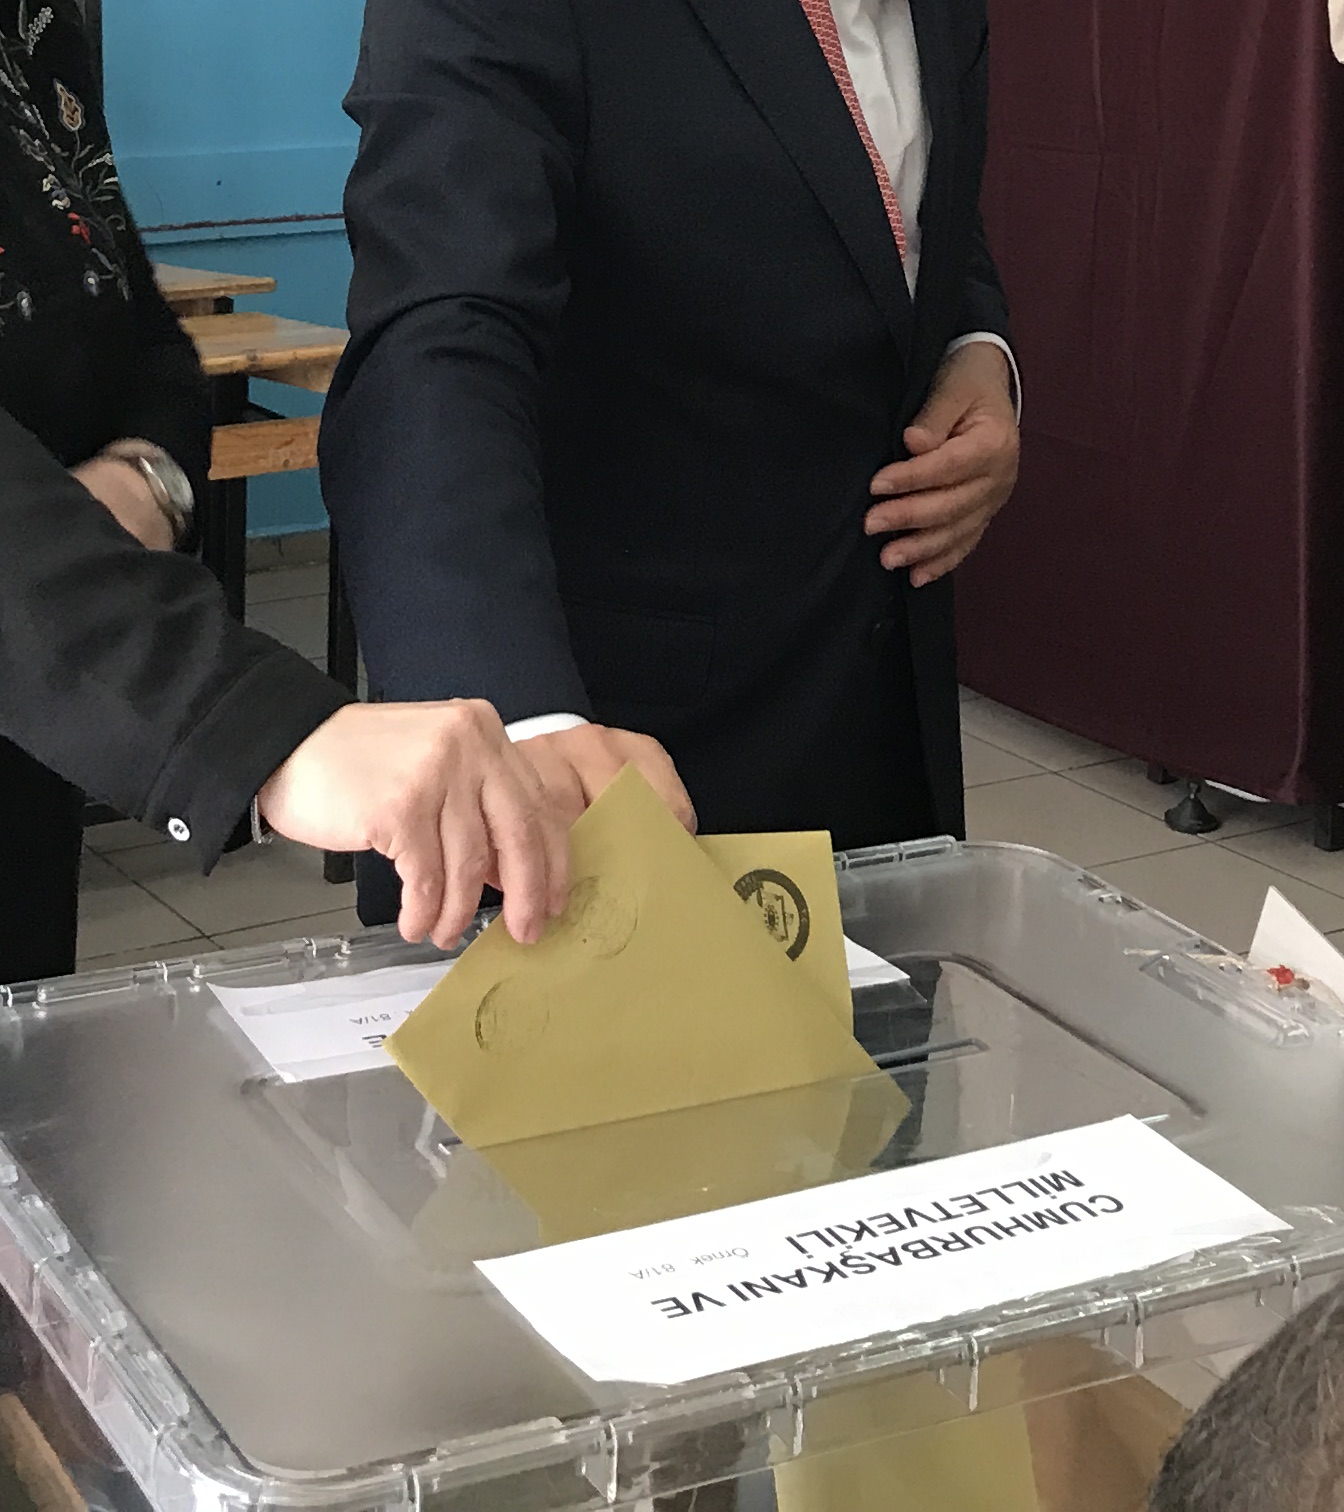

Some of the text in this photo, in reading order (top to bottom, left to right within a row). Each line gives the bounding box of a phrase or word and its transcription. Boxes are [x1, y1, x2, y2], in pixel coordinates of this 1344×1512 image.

[651, 1194, 1124, 1319] CUMHURBAŞKANI VE
[784, 1169, 1086, 1257] MİLLETVEKİLİ
[628, 1246, 750, 1282] Örnek 81/A
